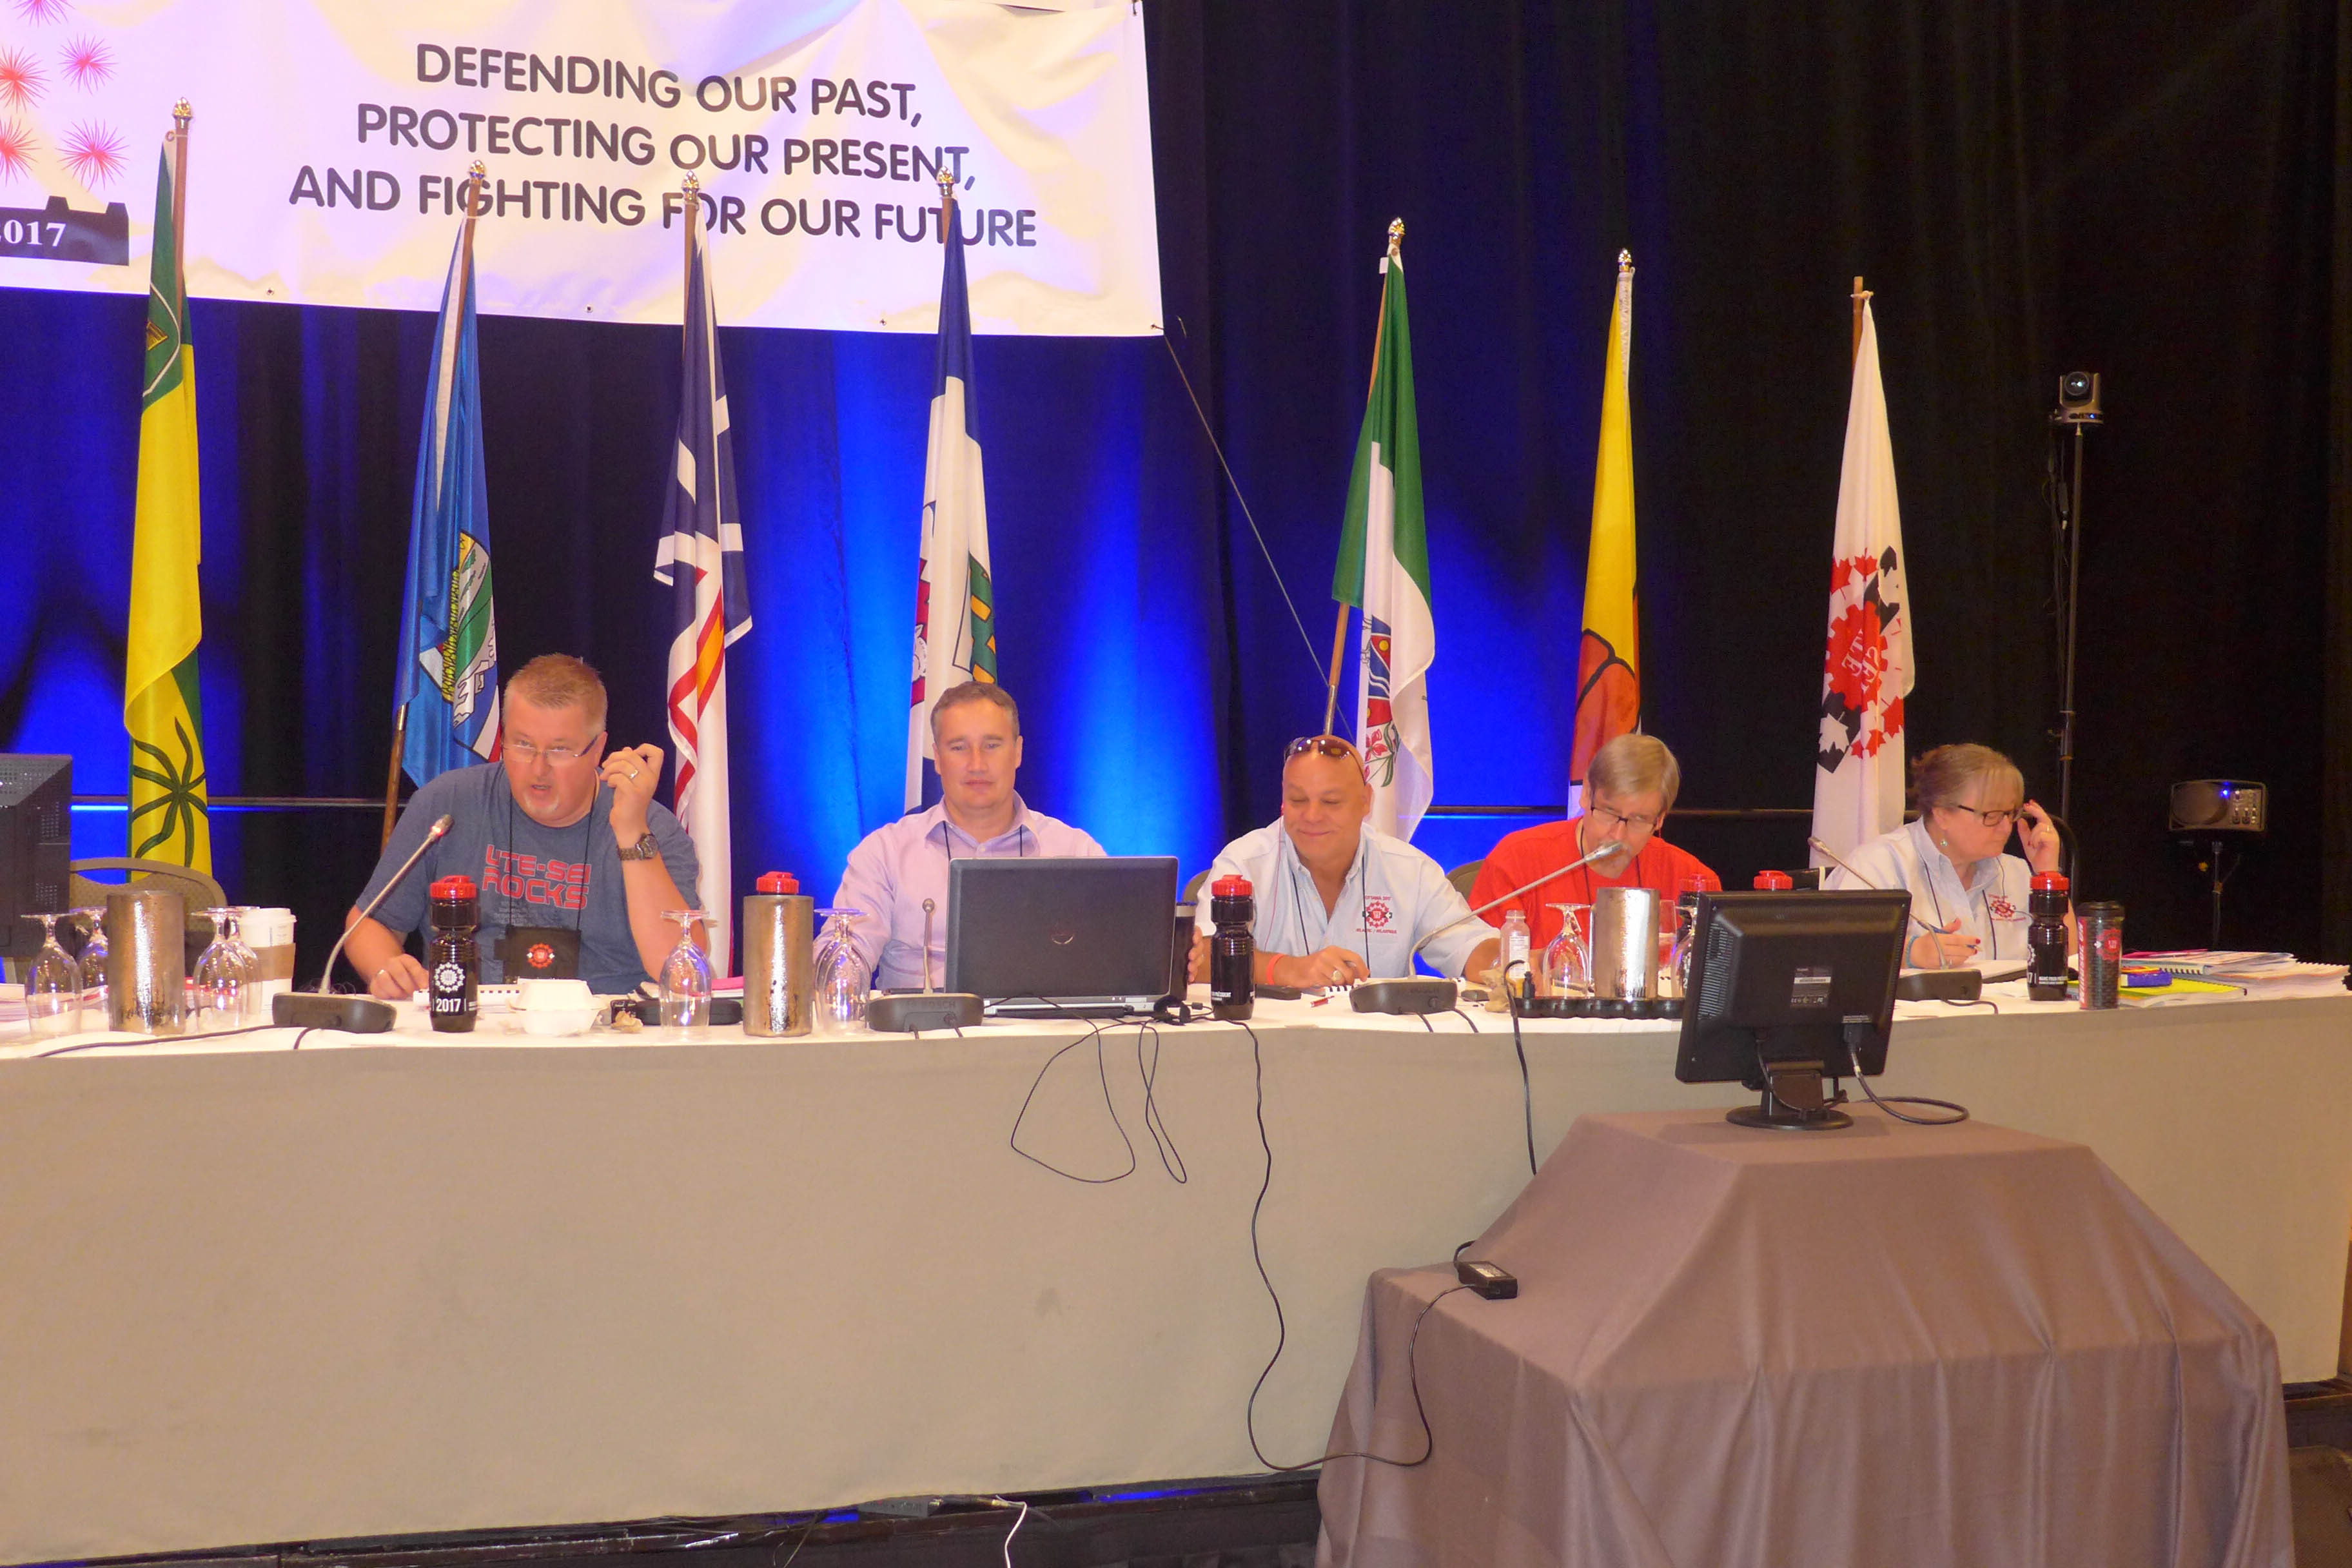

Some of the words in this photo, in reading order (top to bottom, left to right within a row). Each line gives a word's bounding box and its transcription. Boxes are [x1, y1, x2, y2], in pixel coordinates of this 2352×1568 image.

[417, 44, 681, 108] DEFENDING
[696, 75, 796, 113] OUR
[812, 79, 921, 127] PAST,
[358, 103, 655, 166] PROTECTING
[670, 134, 769, 174] OUR
[784, 139, 975, 191] PRESENT,
[289, 166, 400, 211] AND
[419, 175, 645, 226] FIGHTING
[761, 199, 860, 238] OUR
[875, 203, 1037, 246] FUTURE
[0, 219, 66, 247] 017
[485, 845, 591, 885] UTE-SEI
[482, 867, 589, 910] ROCKS
[436, 998, 462, 1012] 2017
